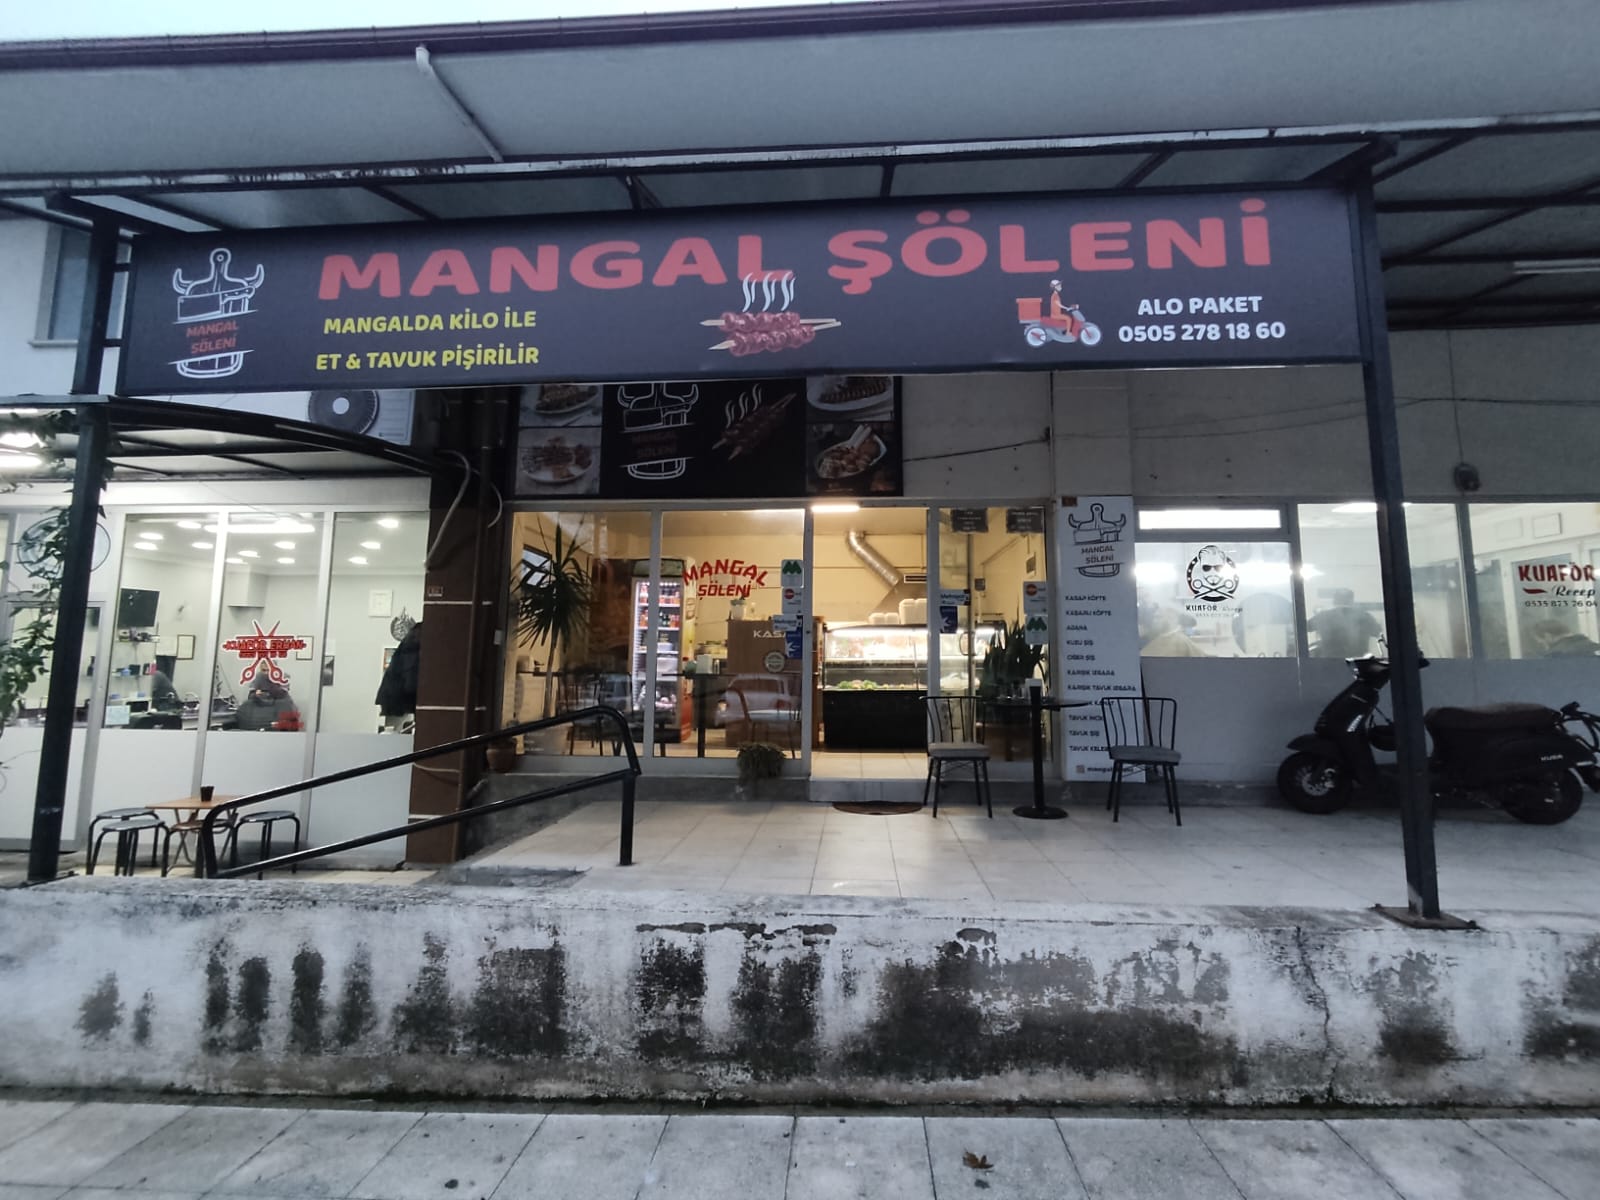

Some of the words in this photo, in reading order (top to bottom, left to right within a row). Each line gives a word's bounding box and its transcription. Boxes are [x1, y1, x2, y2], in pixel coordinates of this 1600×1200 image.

[319, 234, 794, 300] MANGAL
[827, 198, 1271, 295] ŞÖLENİ
[1137, 298, 1183, 316] ALO
[1188, 295, 1263, 315] PAKET
[186, 319, 239, 337] MANGAL
[323, 314, 444, 335] MANGALDA
[449, 311, 499, 331] KİLO
[503, 309, 537, 329] İLE
[1118, 325, 1176, 343] 0505
[1180, 323, 1222, 342] 278
[1225, 322, 1250, 341] 18
[1254, 320, 1287, 340] 60
[315, 353, 342, 371] ET
[346, 352, 361, 370] &
[366, 350, 436, 370] TAVUK
[441, 345, 539, 371] PİŞİRİLİR
[1081, 545, 1115, 554] MANGAL
[682, 558, 768, 586] MANGAL
[1518, 561, 1596, 582] KUAFÖR
[698, 580, 752, 600] ŞÖLENİ
